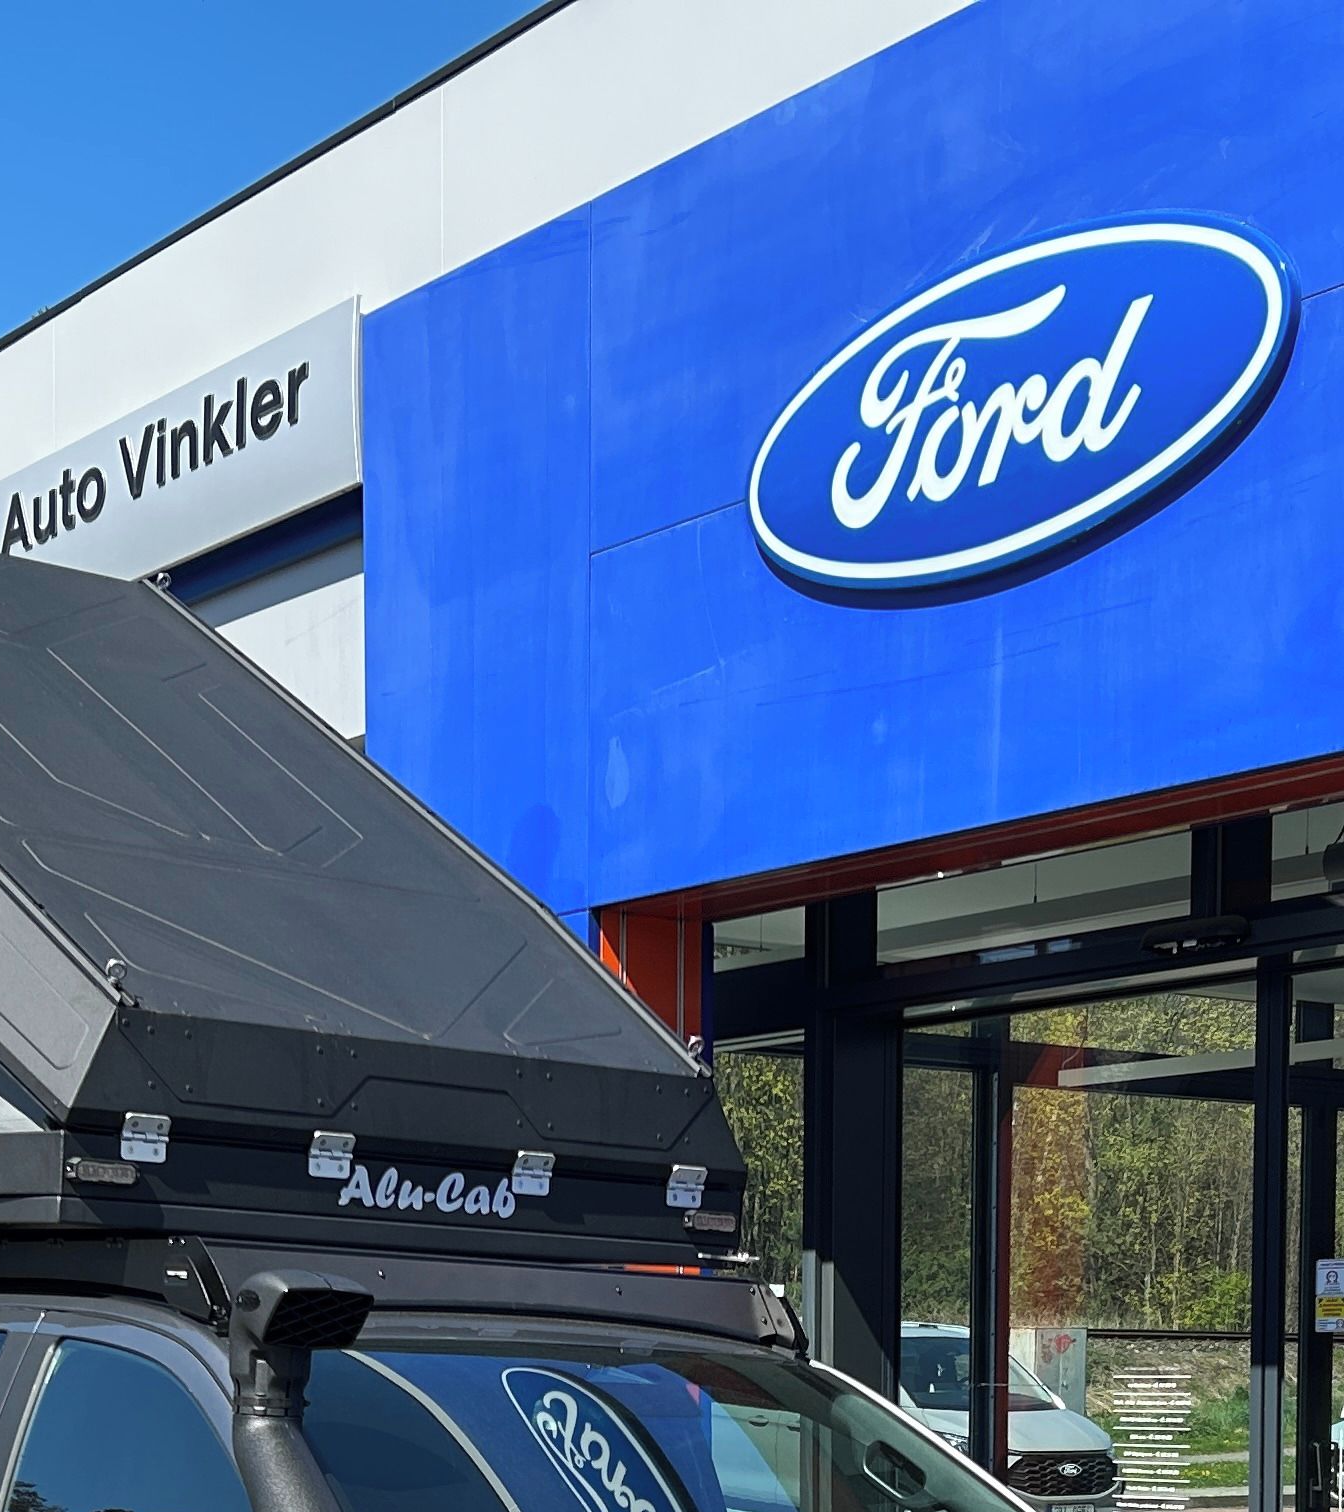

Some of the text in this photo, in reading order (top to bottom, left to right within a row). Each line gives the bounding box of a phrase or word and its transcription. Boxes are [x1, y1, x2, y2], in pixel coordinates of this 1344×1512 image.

[2, 360, 309, 555] Auto Vinkler
[831, 283, 1155, 529] Ford
[338, 1164, 517, 1219] Alu-Cab
